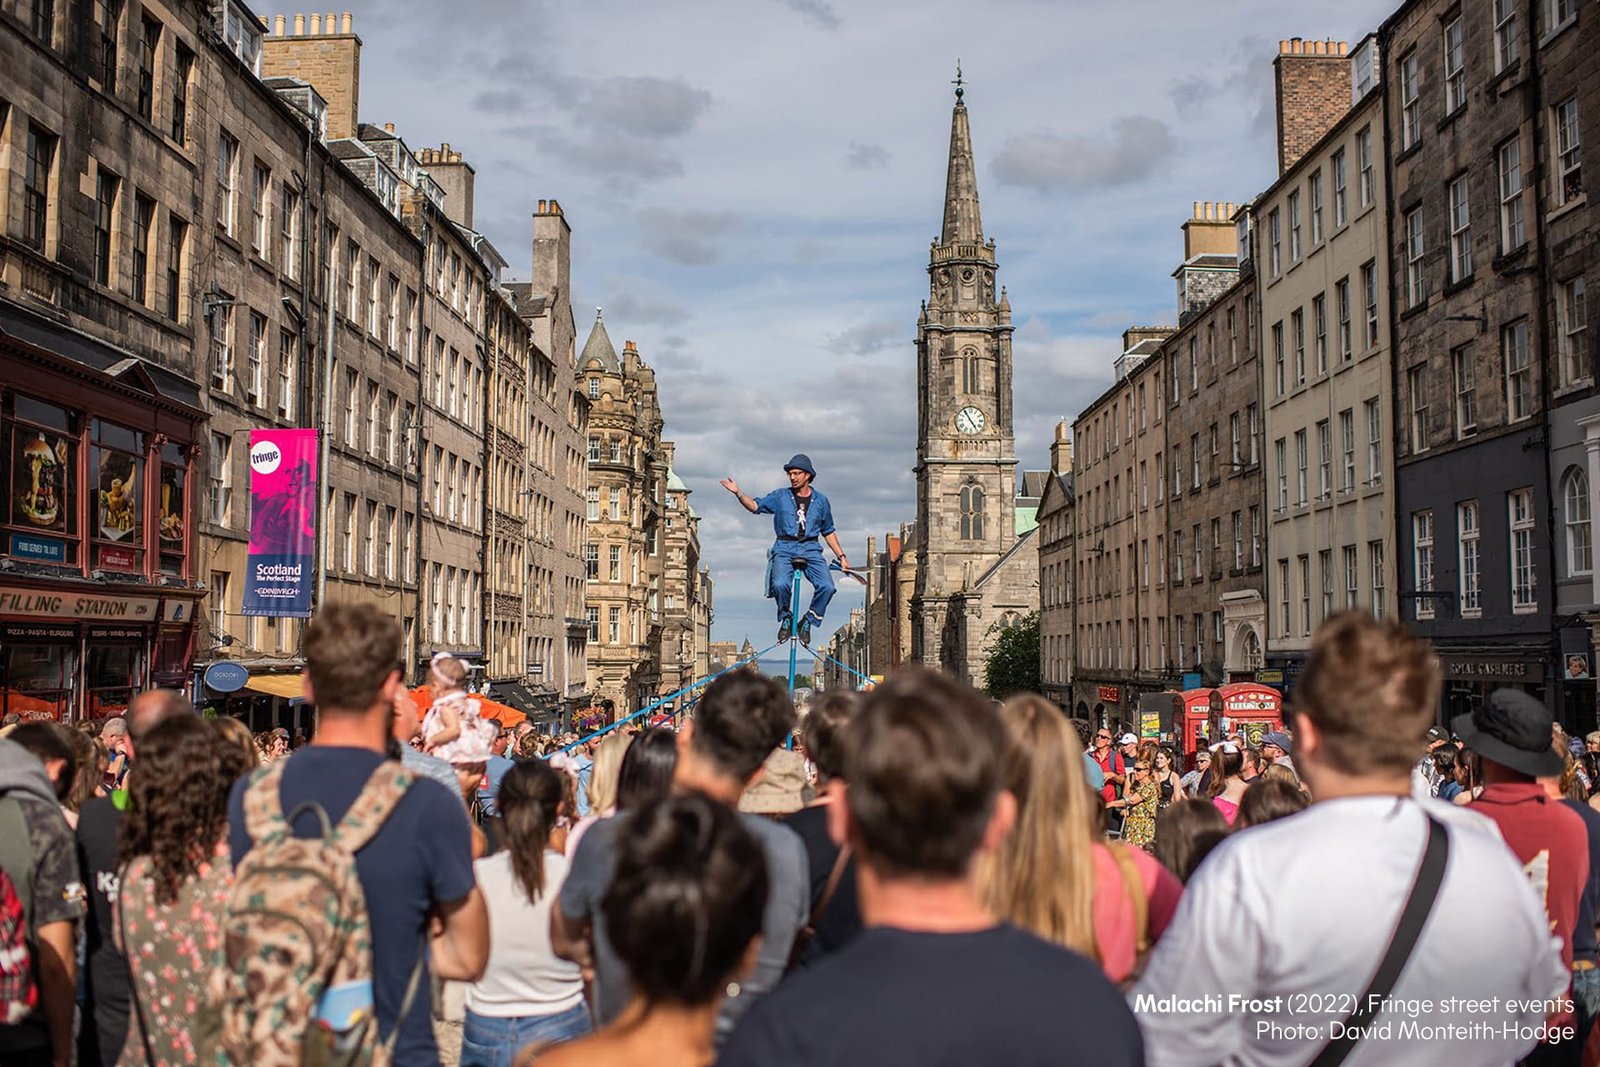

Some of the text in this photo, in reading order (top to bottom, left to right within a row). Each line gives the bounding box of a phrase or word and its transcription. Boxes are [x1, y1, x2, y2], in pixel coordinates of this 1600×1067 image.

[251, 450, 279, 464] fringe
[256, 563, 302, 576] Scotland
[0, 593, 62, 612] FILLING
[74, 598, 128, 616] STATION
[7, 628, 74, 638] PIZZA PASTA BURGERS
[1451, 663, 1526, 676] ROYAL CASHMERE
